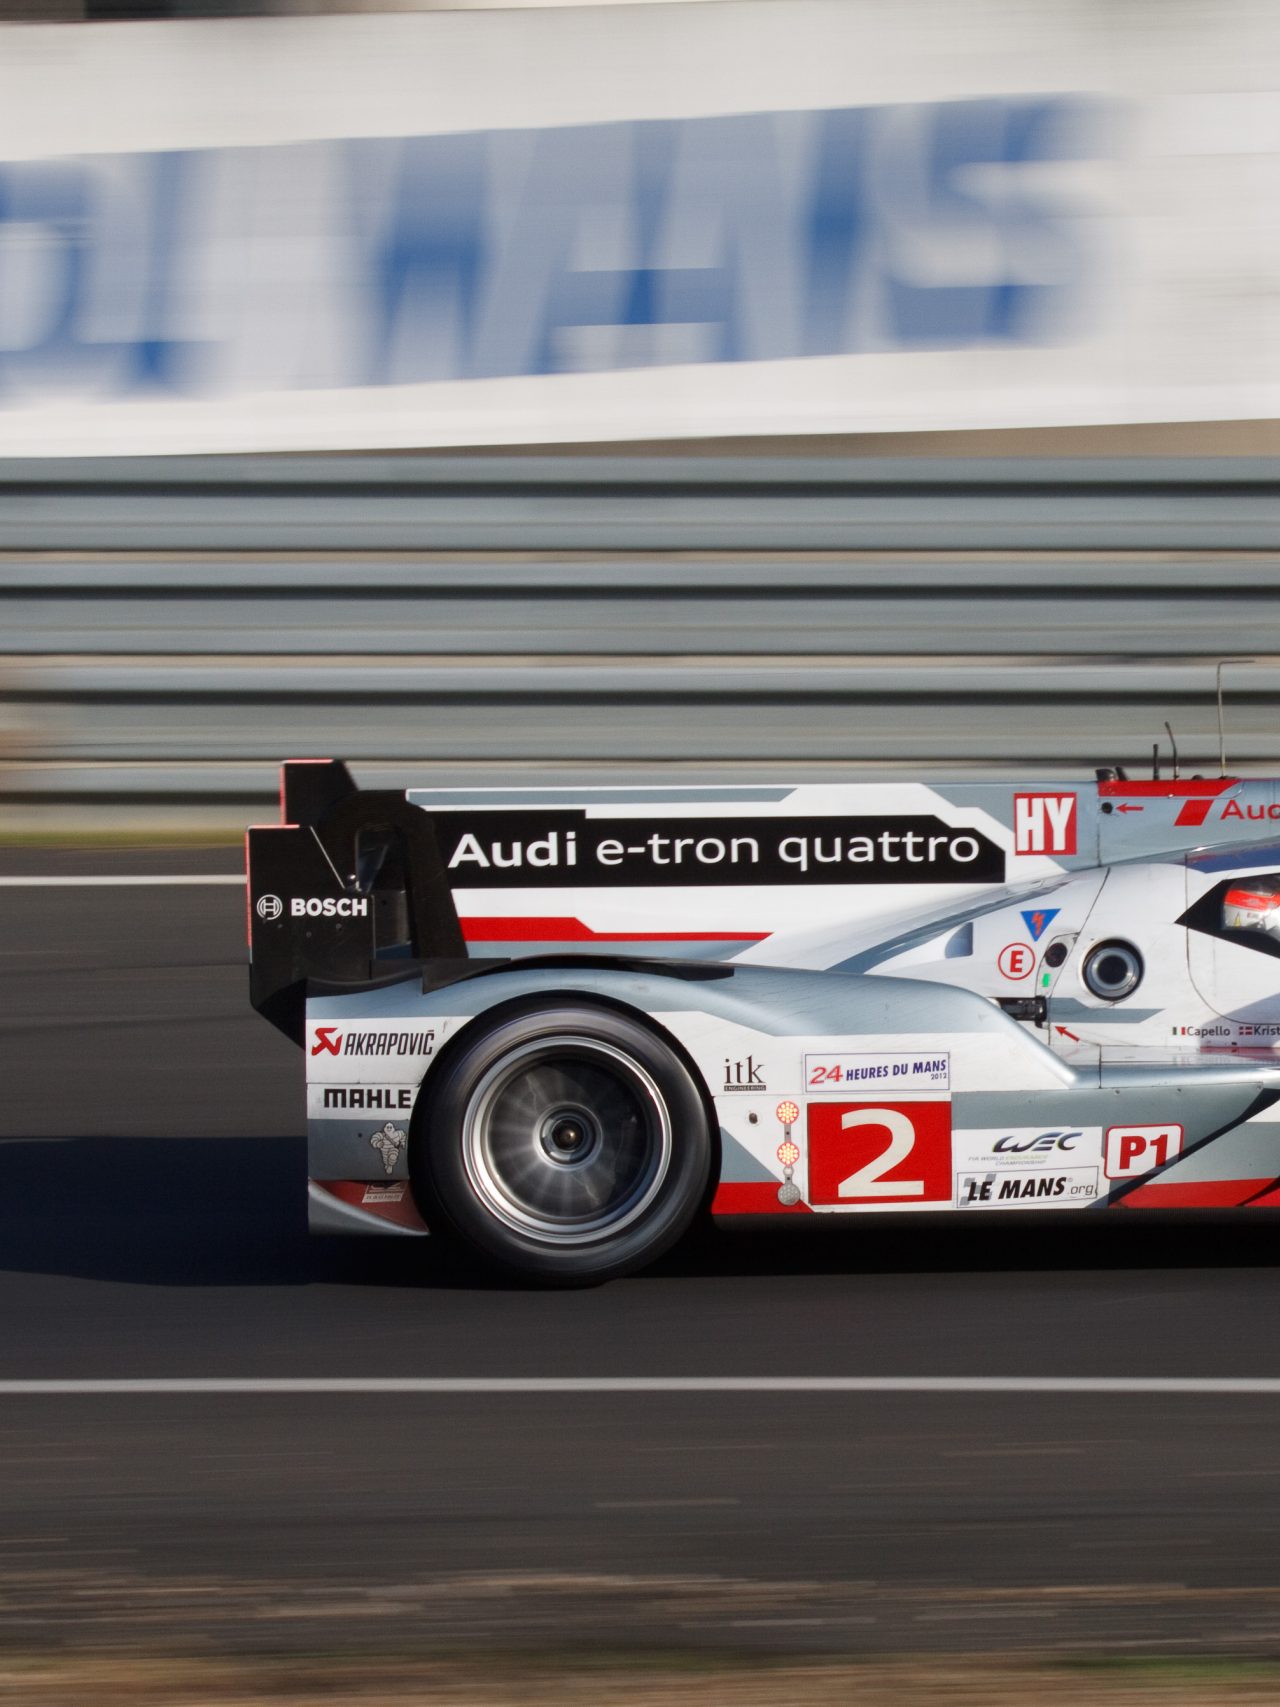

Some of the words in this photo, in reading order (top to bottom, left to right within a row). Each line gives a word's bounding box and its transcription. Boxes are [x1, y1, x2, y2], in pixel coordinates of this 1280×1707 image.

[1016, 797, 1075, 851] HY
[448, 831, 577, 868] Audi
[596, 831, 760, 865] e-tron
[778, 829, 980, 872] quattro
[291, 898, 368, 916] BOSCH
[1010, 950, 1024, 973] E
[1187, 1026, 1231, 1037] Capello
[724, 1055, 765, 1084] itk
[809, 1064, 844, 1085] 24
[845, 1065, 889, 1081] HEURES
[892, 1063, 908, 1076] DU
[912, 1059, 947, 1074] MANS
[930, 1072, 947, 1081] 2012
[324, 1089, 412, 1109] MAHLE
[838, 1108, 925, 1198] 2
[1119, 1134, 1169, 1170] P1
[967, 1181, 993, 1201] LE
[998, 1176, 1067, 1200] MANS
